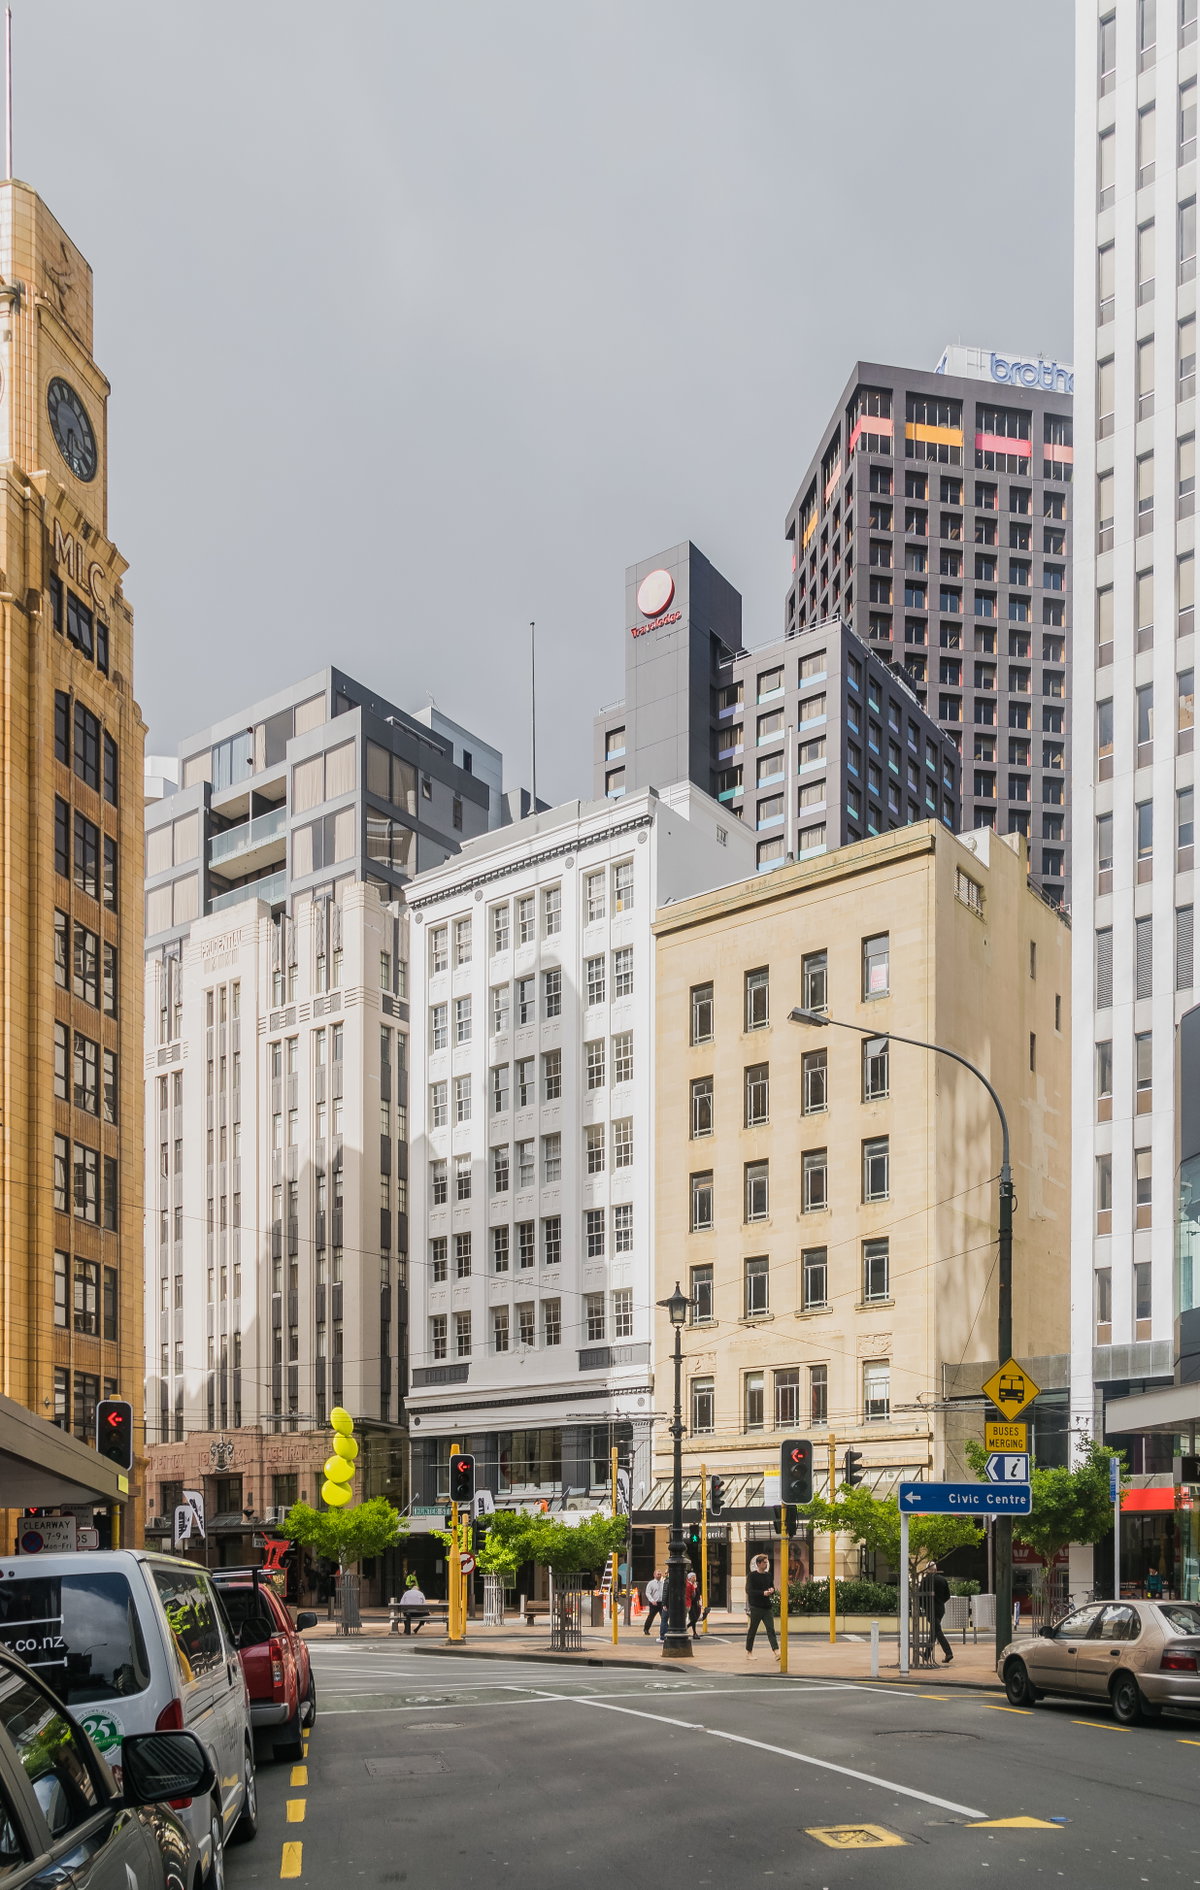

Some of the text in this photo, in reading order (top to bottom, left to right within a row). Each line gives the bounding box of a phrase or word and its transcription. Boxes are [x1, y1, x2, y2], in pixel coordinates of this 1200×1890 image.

[54, 517, 105, 611] MLC
[631, 611, 682, 639] Travelodge
[993, 1426, 1019, 1436] BUSES
[989, 1439, 1023, 1448] MERGING
[948, 1493, 1027, 1505] Civic Centre
[23, 1520, 71, 1530] CLEARWAY
[46, 1532, 61, 1541] 7-9
[44, 1543, 72, 1551] Mon-Fri
